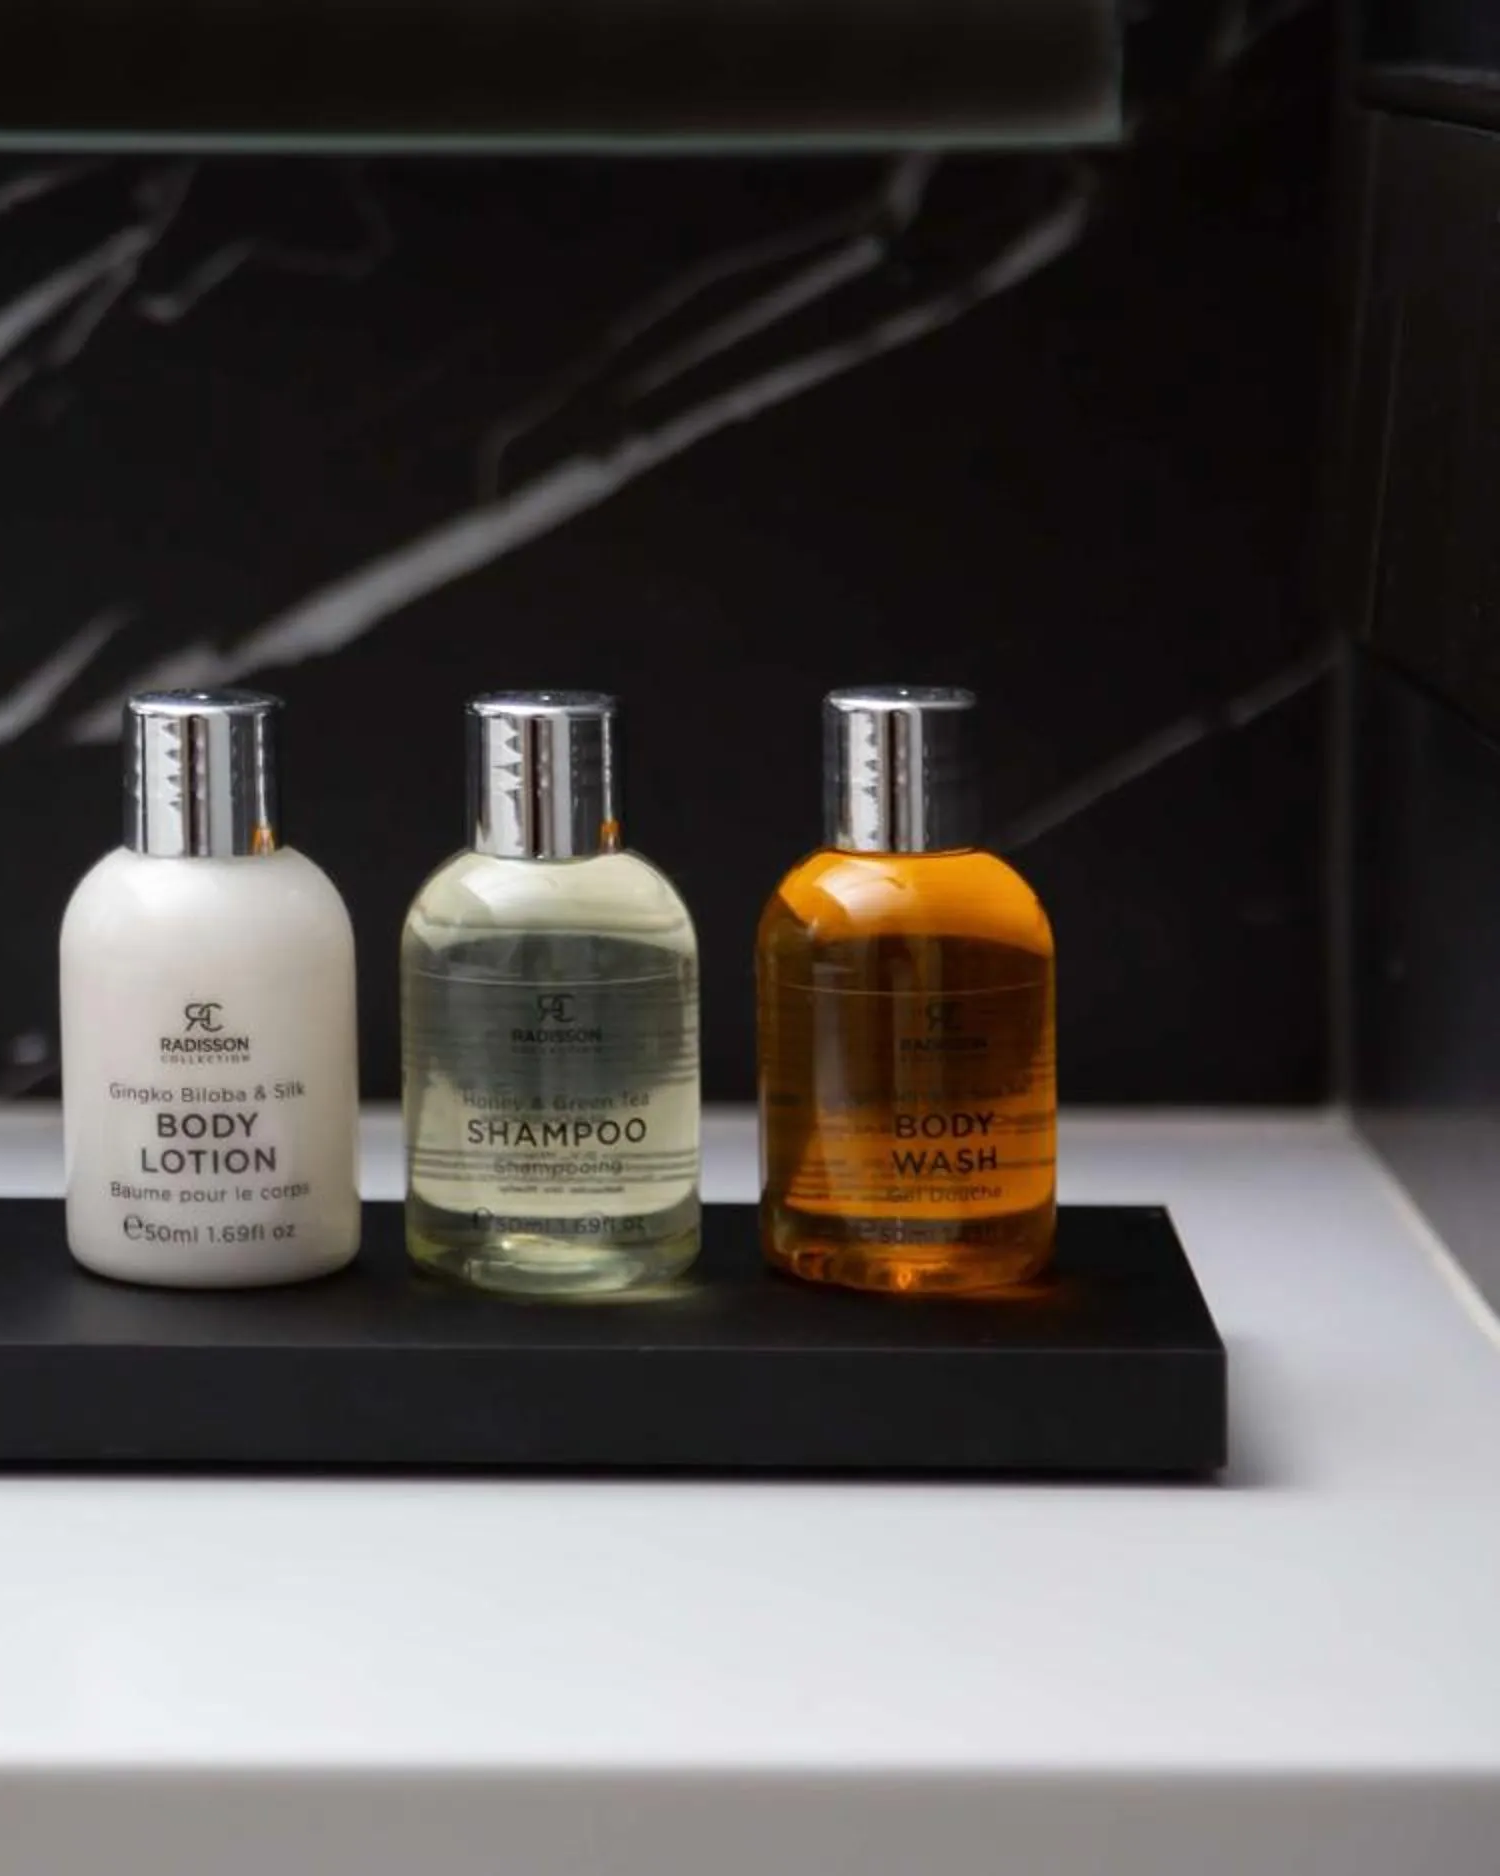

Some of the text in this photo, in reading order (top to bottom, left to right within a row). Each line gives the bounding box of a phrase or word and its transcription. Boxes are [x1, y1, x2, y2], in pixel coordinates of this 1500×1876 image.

[160, 1036, 250, 1053] RADISSON
[511, 1028, 603, 1043] RADISSON
[109, 1080, 306, 1104] Gingko Biloba & Silk
[157, 1112, 258, 1139] BODY
[467, 1117, 647, 1147] SHAMPOO
[894, 1111, 995, 1139] BODY
[141, 1147, 277, 1174] LOTION
[891, 1145, 998, 1175] WASH
[110, 1181, 310, 1205] Baume pour le corps
